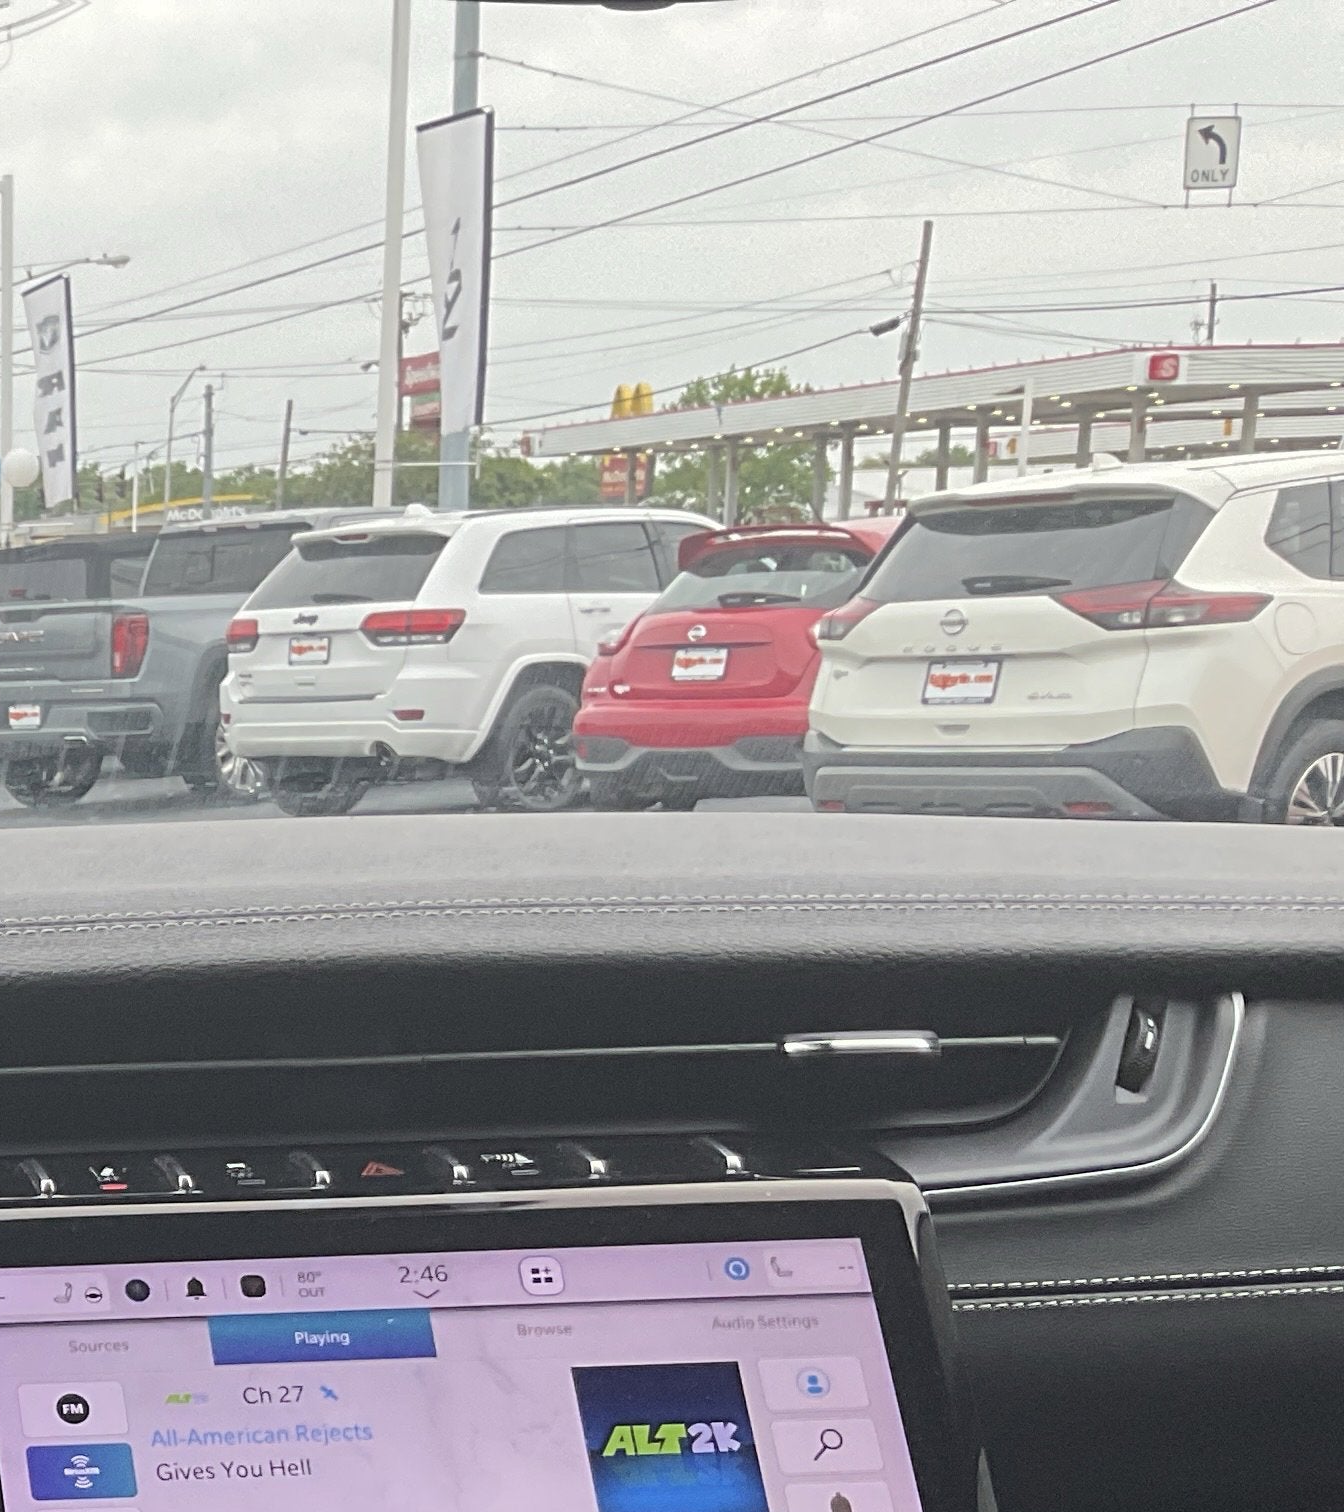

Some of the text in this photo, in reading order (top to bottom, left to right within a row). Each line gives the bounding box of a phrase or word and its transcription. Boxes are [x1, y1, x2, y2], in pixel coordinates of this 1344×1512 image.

[1190, 168, 1230, 184] ONLY
[398, 1264, 449, 1285] 2:46
[298, 1285, 325, 1298] OUT
[516, 1323, 573, 1337] Browse
[712, 1313, 820, 1331] Audio Settings
[68, 1338, 130, 1354] Sources
[294, 1330, 351, 1348] Playing
[242, 1385, 305, 1404] Ch 27
[62, 1402, 85, 1415] FM
[150, 1423, 374, 1448] All-American Rejects
[156, 1457, 313, 1482] Gives You Hell
